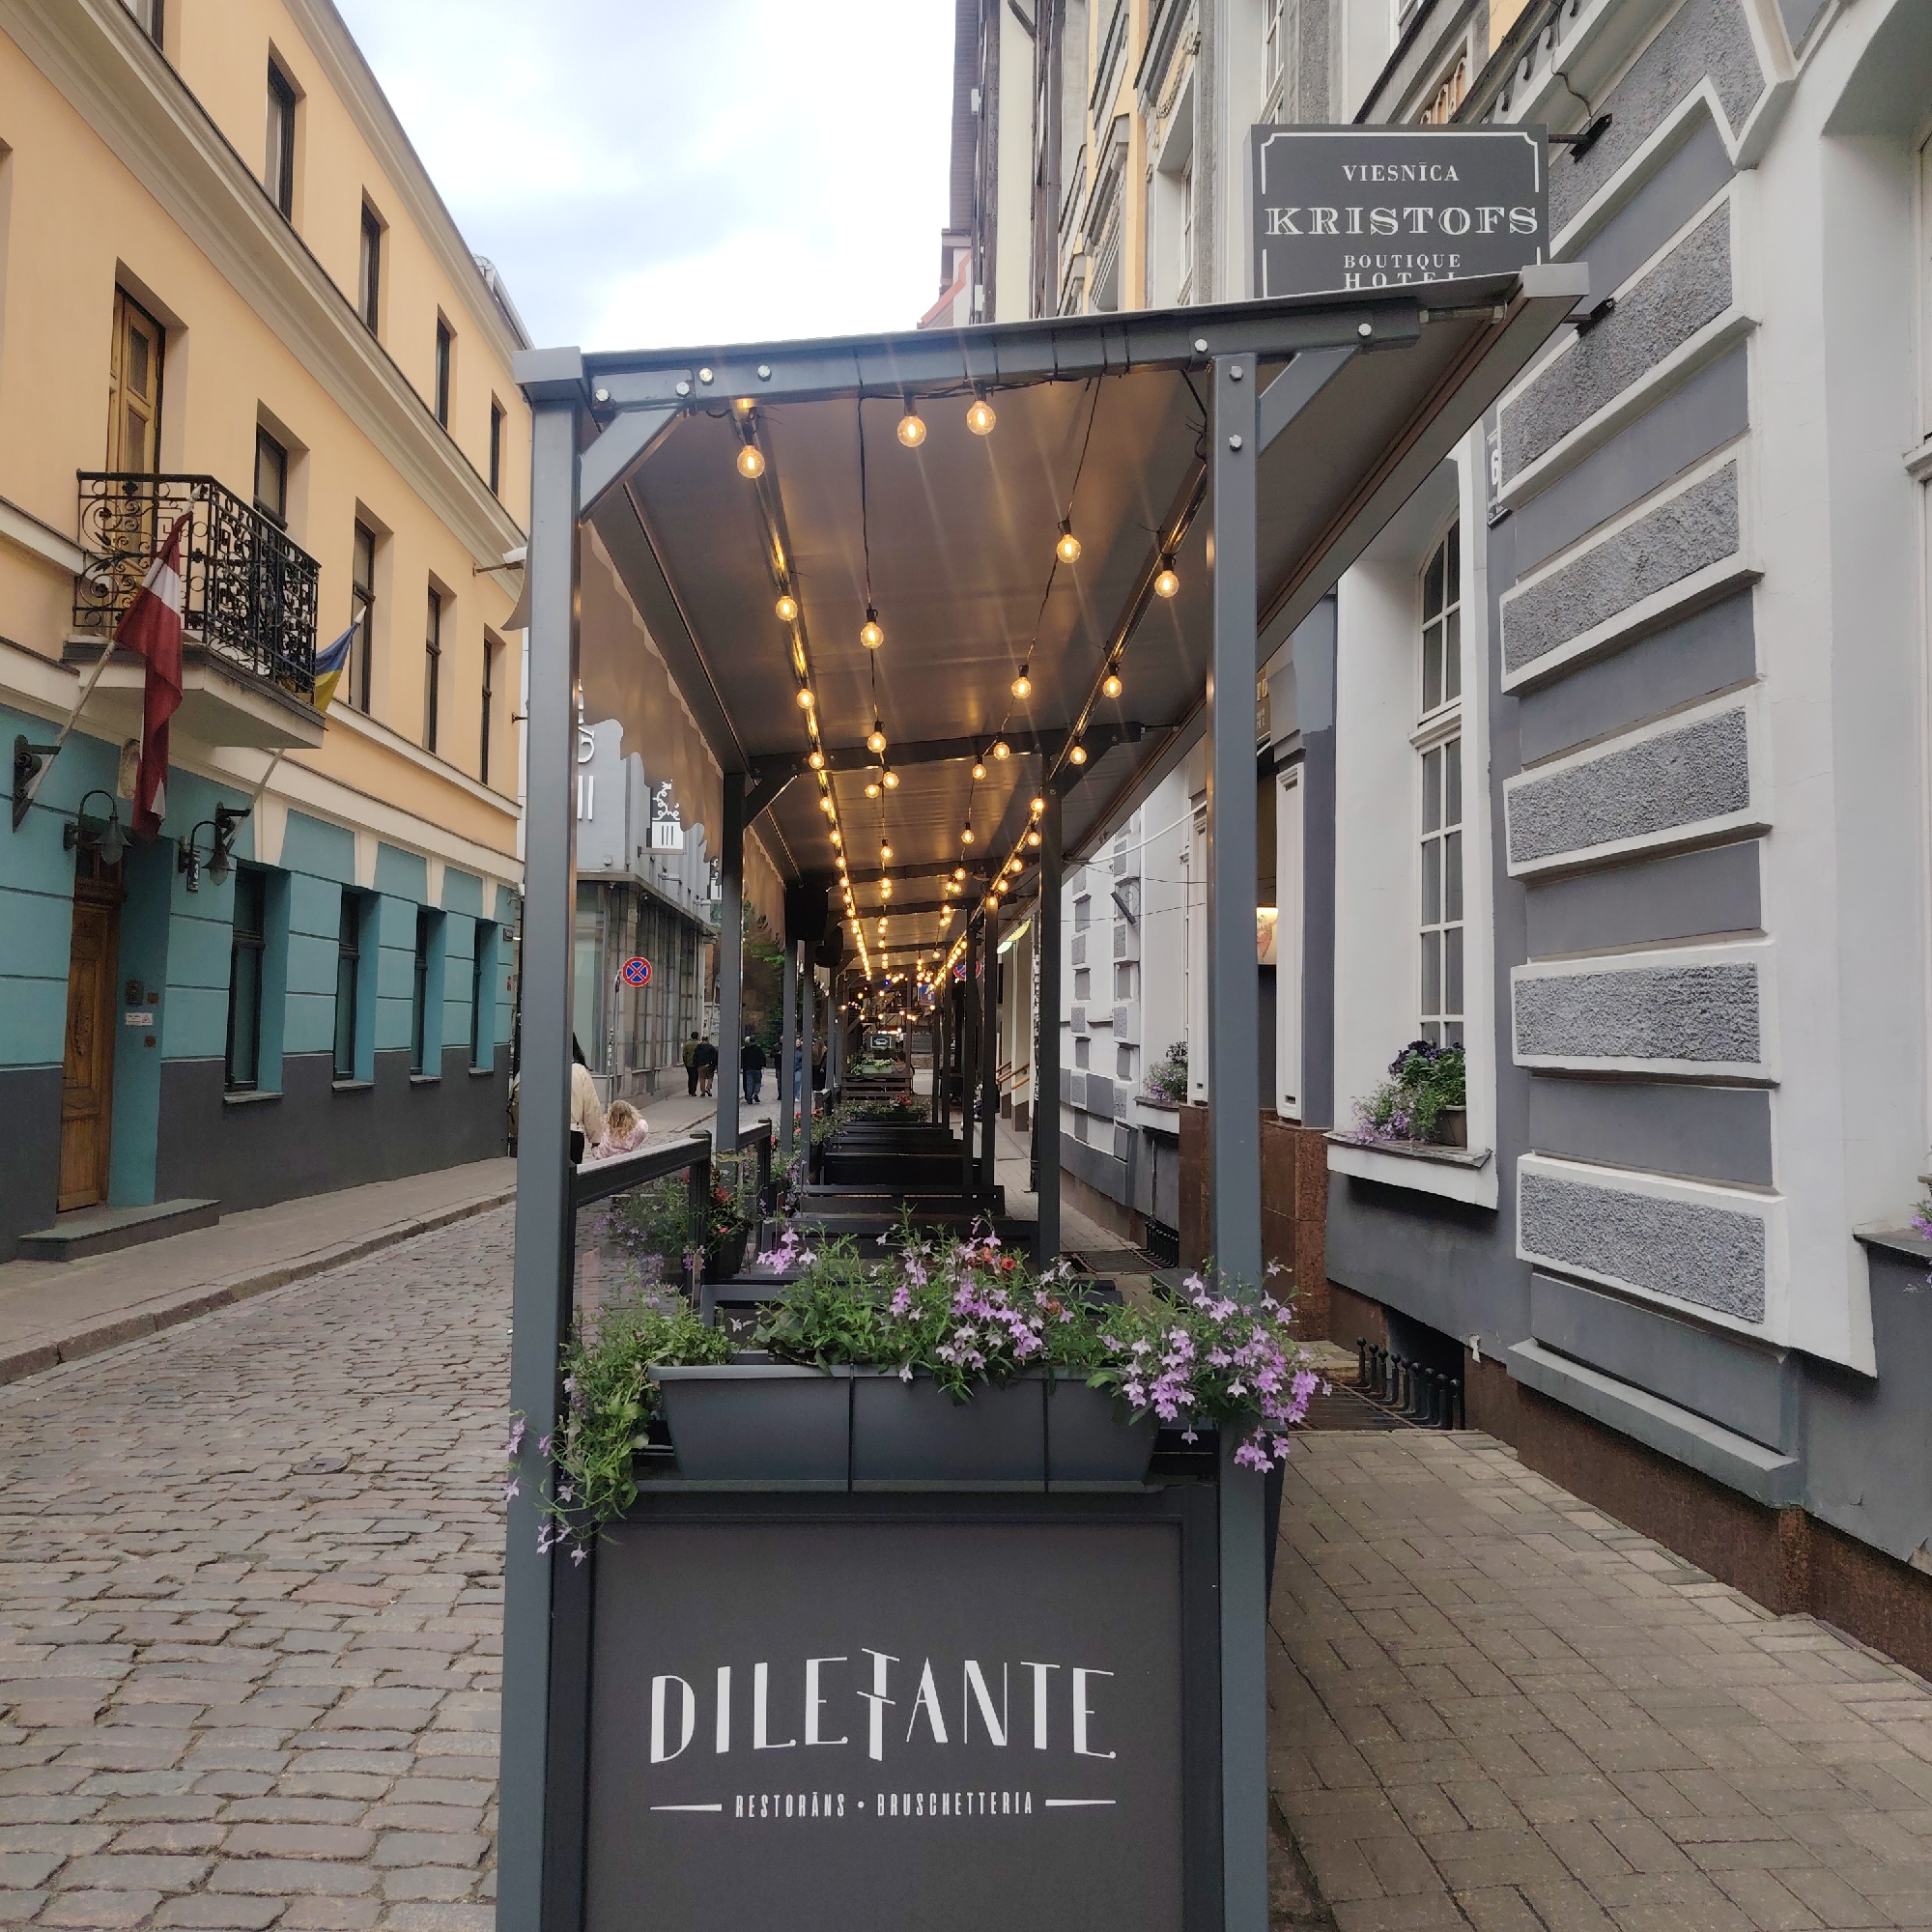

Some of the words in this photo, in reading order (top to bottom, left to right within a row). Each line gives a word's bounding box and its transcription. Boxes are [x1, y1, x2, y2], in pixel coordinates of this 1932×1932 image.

[1342, 162, 1460, 182] VIESNĪCA
[1264, 207, 1538, 236] KRISTOFS
[1344, 254, 1461, 270] BOUTIQUE
[735, 1792, 845, 1818] RESTORĀNS
[877, 1791, 1033, 1817] BRUSCHETTERIA
